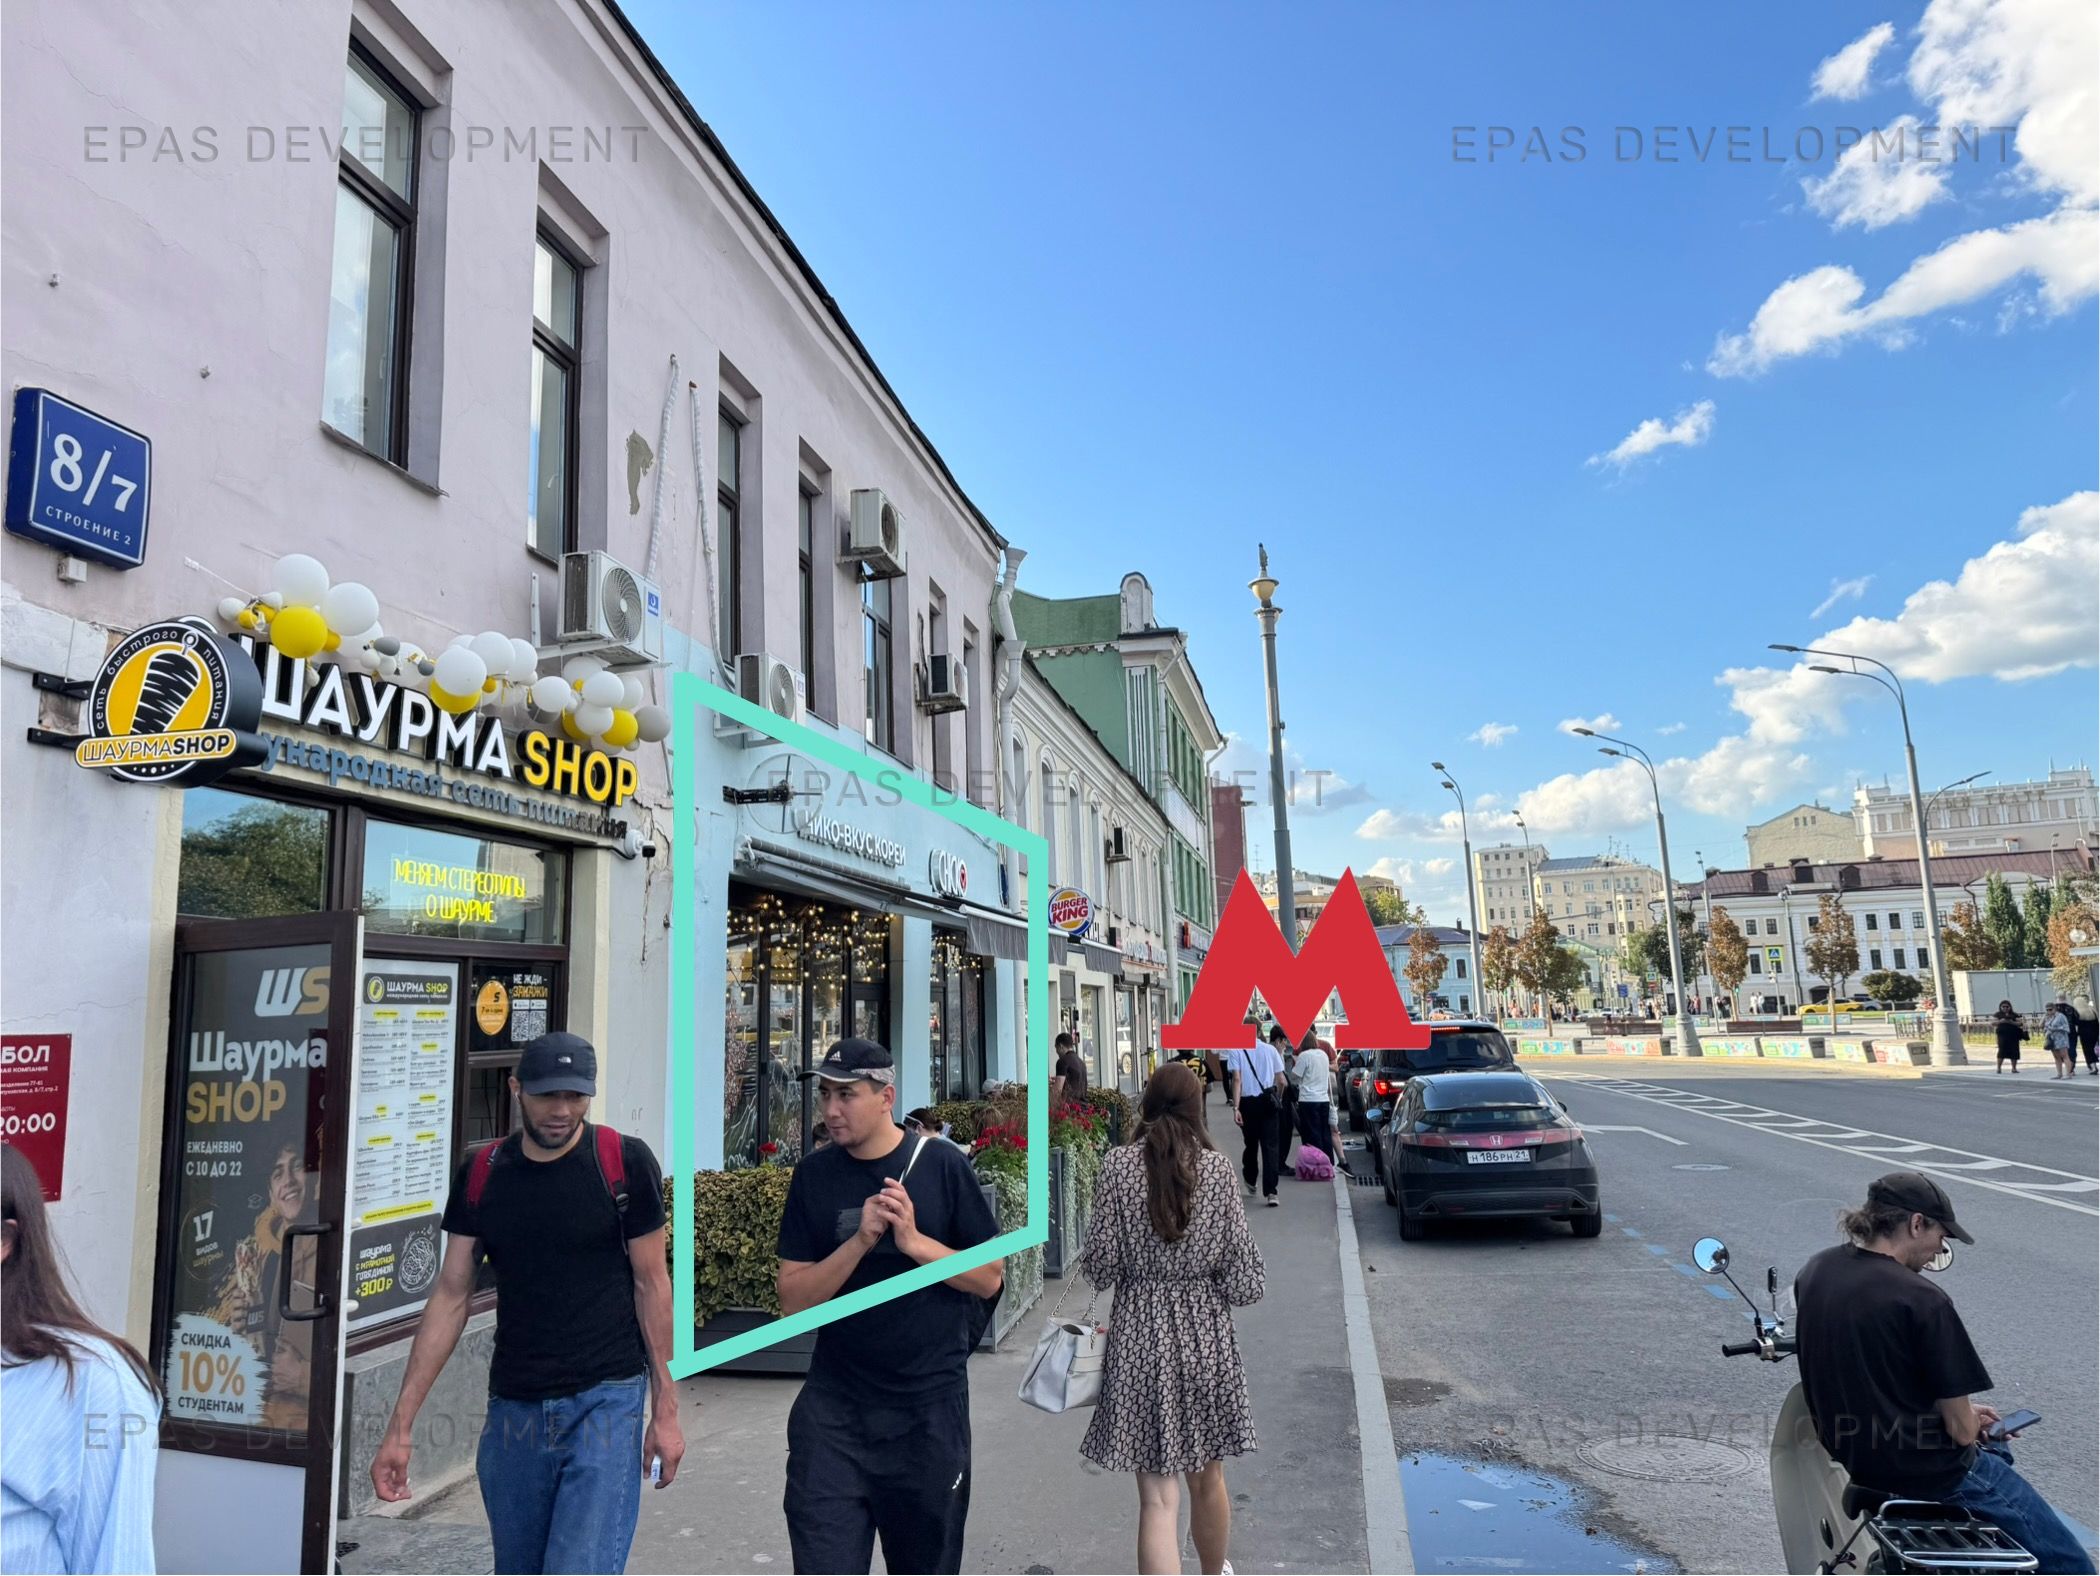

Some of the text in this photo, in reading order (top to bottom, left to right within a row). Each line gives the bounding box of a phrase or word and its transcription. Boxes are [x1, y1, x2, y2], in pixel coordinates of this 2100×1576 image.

[51, 433, 138, 512] 8/7
[46, 505, 131, 545] СТРОЕНИЕ 2
[96, 630, 224, 729] сеть быстрого питания
[240, 633, 638, 808] ШАУРМА SHOP
[262, 732, 443, 798] ународная
[1051, 897, 1088, 913] BURGER
[1052, 904, 1089, 924] KING
[387, 981, 448, 993] ШАУРМА SHOP
[513, 974, 522, 983] НЕ
[524, 974, 542, 985] ЖДИ
[1, 1045, 50, 1064] БОЛ
[190, 1031, 327, 1082] Шаурма
[186, 1080, 286, 1123] SHOP
[187, 1141, 243, 1153] ЕЖЕДНЕВНО
[186, 1162, 242, 1177] С 10 ДО 22
[193, 1210, 214, 1242] 17
[181, 1332, 231, 1349] СКИДКА
[179, 1351, 245, 1396] 10%
[177, 1397, 244, 1414] СТУДЕНТАМ
